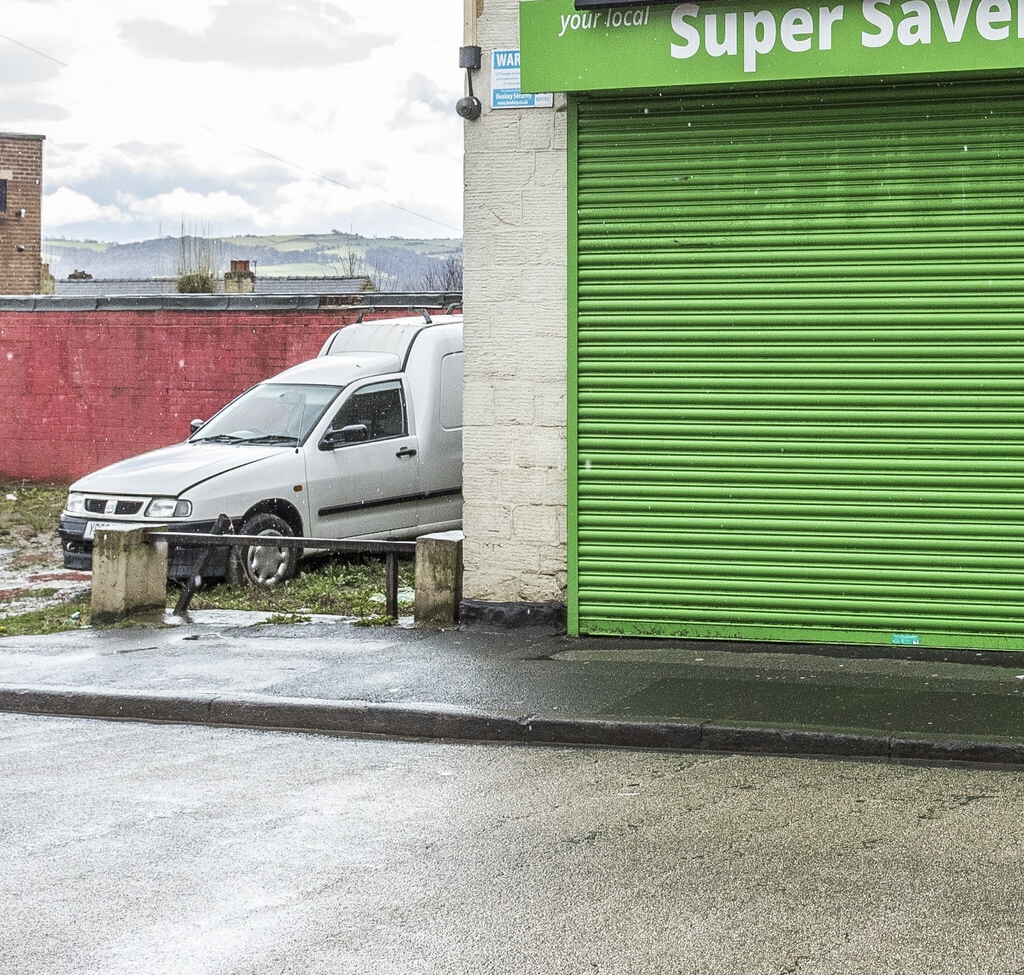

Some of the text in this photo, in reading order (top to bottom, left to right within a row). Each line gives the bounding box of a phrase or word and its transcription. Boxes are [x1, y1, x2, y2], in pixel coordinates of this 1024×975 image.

[558, 11, 601, 37] your
[606, 6, 650, 28] local
[670, 3, 844, 73] Super
[496, 53, 520, 66] WAR
